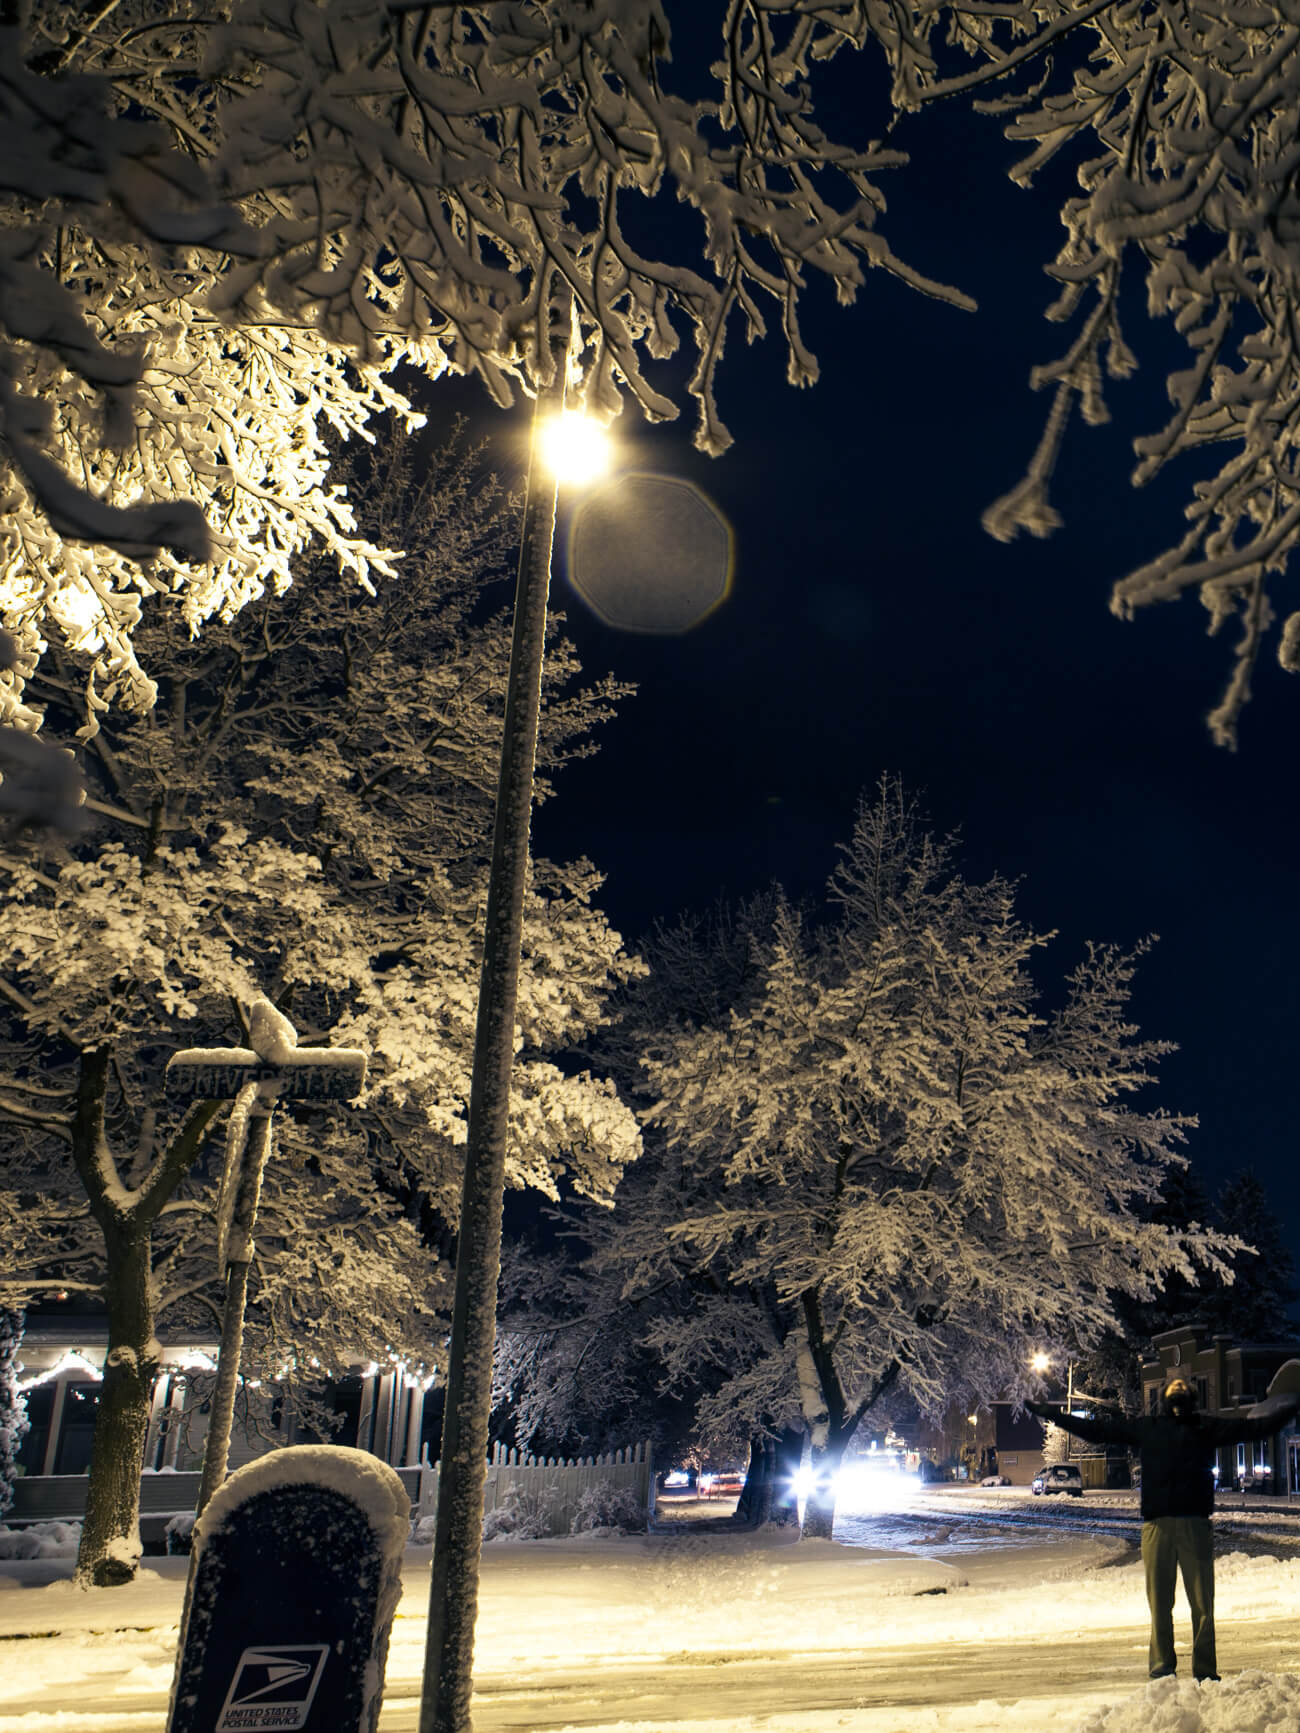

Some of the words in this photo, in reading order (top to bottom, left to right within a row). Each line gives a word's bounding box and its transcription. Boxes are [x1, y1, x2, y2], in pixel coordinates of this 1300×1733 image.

[225, 1708, 263, 1718] UNITED
[264, 1706, 298, 1716] STATES
[223, 1719, 257, 1728] POSTAL
[262, 1718, 299, 1727] SERVICE
